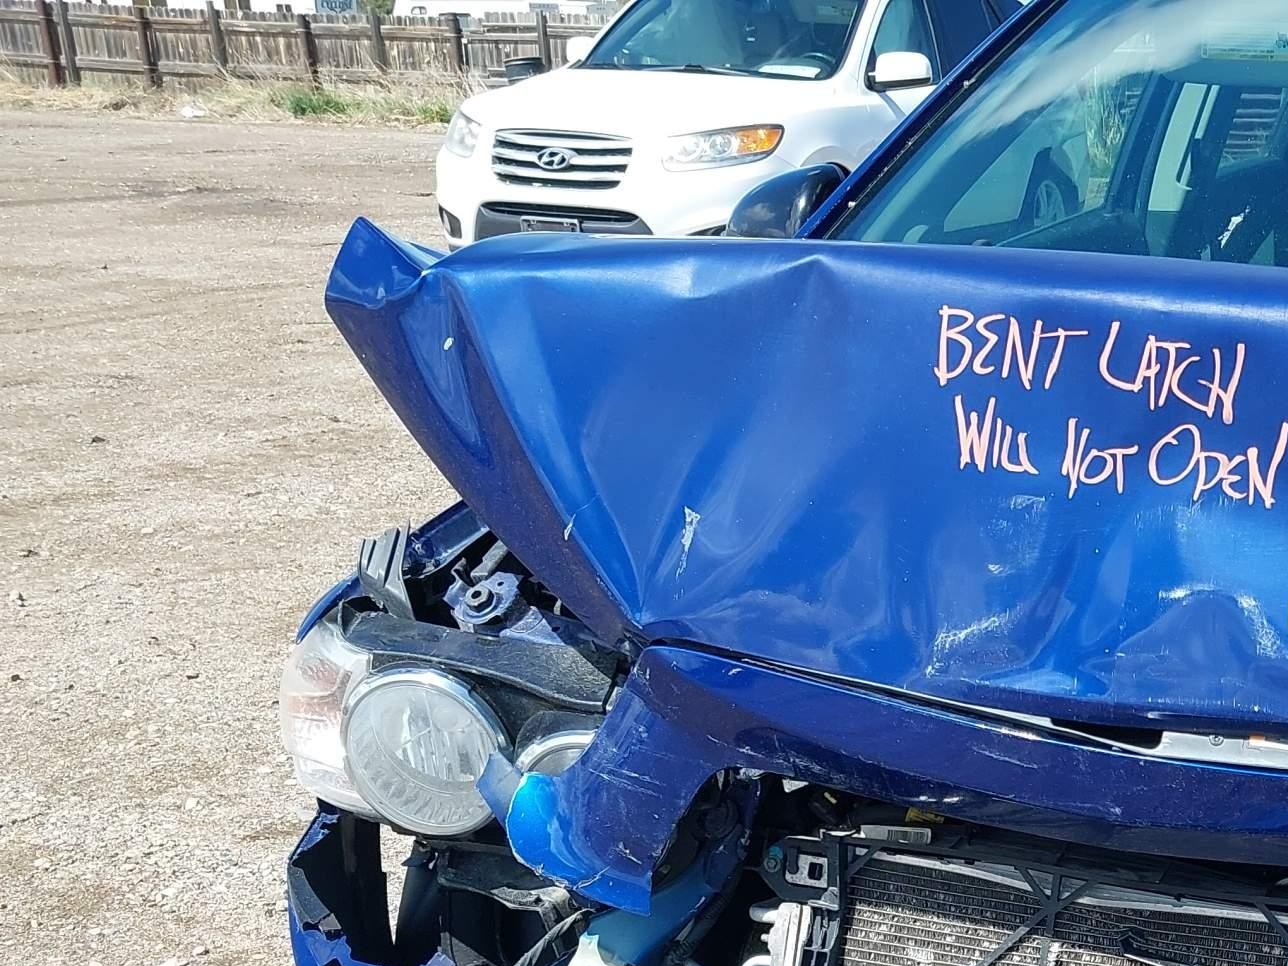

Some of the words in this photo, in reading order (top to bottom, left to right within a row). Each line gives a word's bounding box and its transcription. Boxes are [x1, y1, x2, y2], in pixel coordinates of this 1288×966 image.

[934, 304, 1089, 390] BENT
[1099, 320, 1246, 425] LATCH
[954, 394, 1040, 475] WILL
[1061, 417, 1139, 500] NOT
